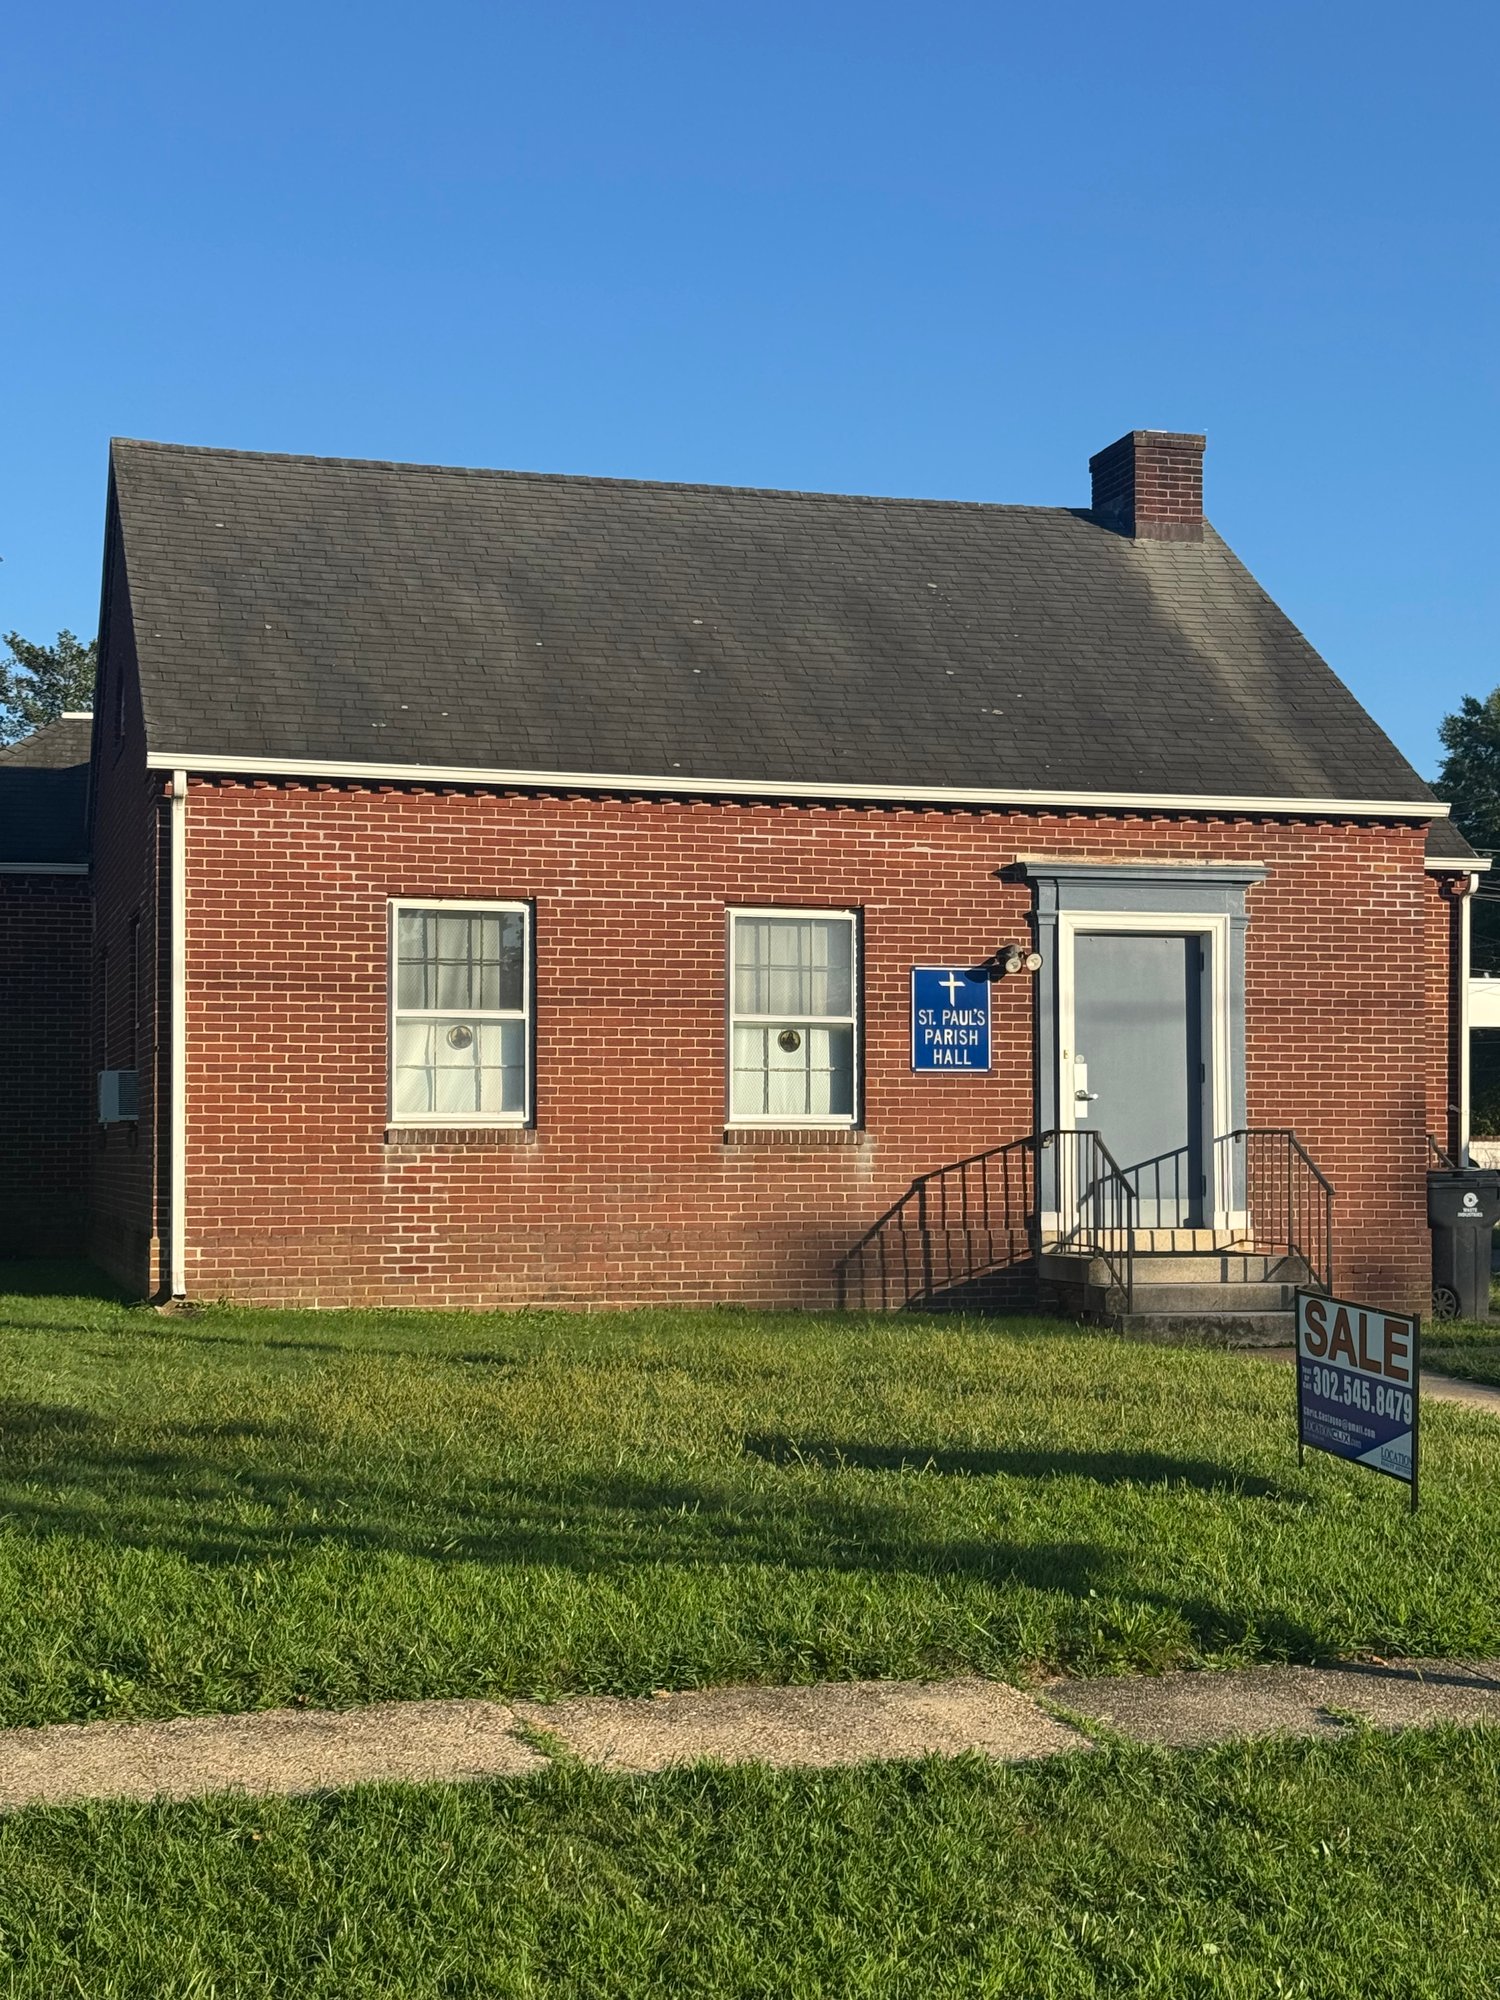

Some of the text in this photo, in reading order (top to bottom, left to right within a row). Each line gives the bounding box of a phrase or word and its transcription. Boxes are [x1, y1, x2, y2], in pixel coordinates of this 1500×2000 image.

[918, 1008, 986, 1026] ST. PAUL'S
[924, 1029, 979, 1046] PARISH
[933, 1048, 972, 1065] HALL
[1304, 1299, 1409, 1382] SALE
[1312, 1366, 1413, 1426] 302.545.8479
